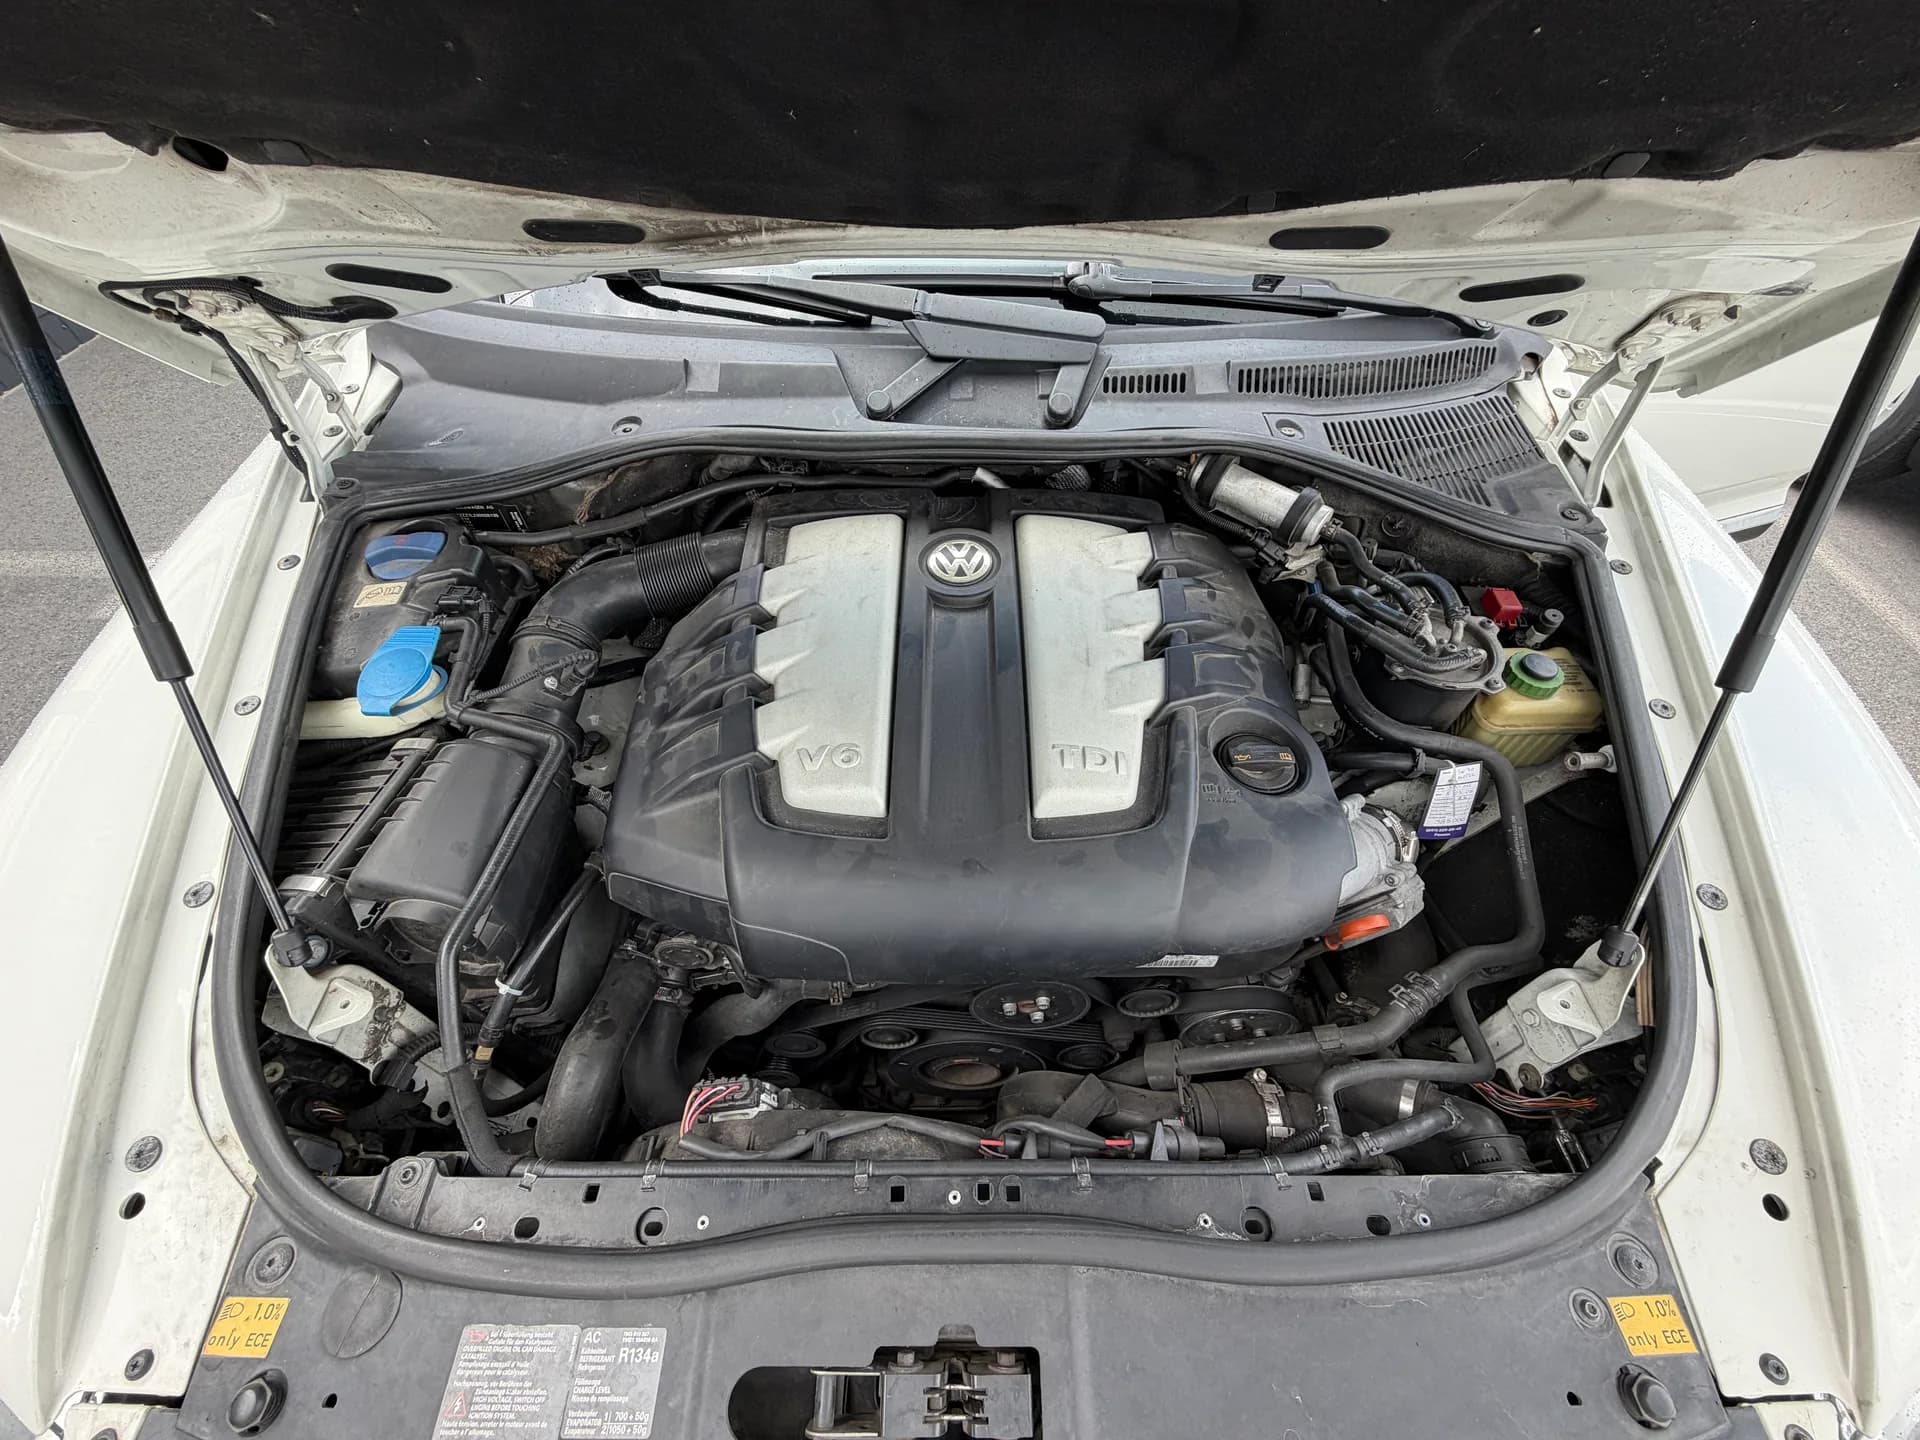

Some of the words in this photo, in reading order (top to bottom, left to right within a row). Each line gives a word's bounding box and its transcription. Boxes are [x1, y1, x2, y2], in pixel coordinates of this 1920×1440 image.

[796, 742, 863, 772] V6
[1050, 743, 1129, 776] TDI
[254, 1303, 284, 1320] 1.0%
[1644, 1300, 1676, 1318] 1.0%
[207, 1328, 241, 1350] only
[245, 1333, 272, 1347] ECE
[584, 1331, 601, 1343] AC
[1628, 1331, 1658, 1348] only
[1662, 1329, 1690, 1344] ECE
[618, 1347, 659, 1363] R134a
[573, 1386, 595, 1394] CHARGE
[595, 1386, 611, 1394] LEVEL
[566, 1418, 602, 1426] EVAPORATOR
[615, 1411, 627, 1421] 700
[634, 1411, 650, 1423] 50g
[609, 1425, 626, 1434] 1050
[632, 1425, 647, 1436] 50g
